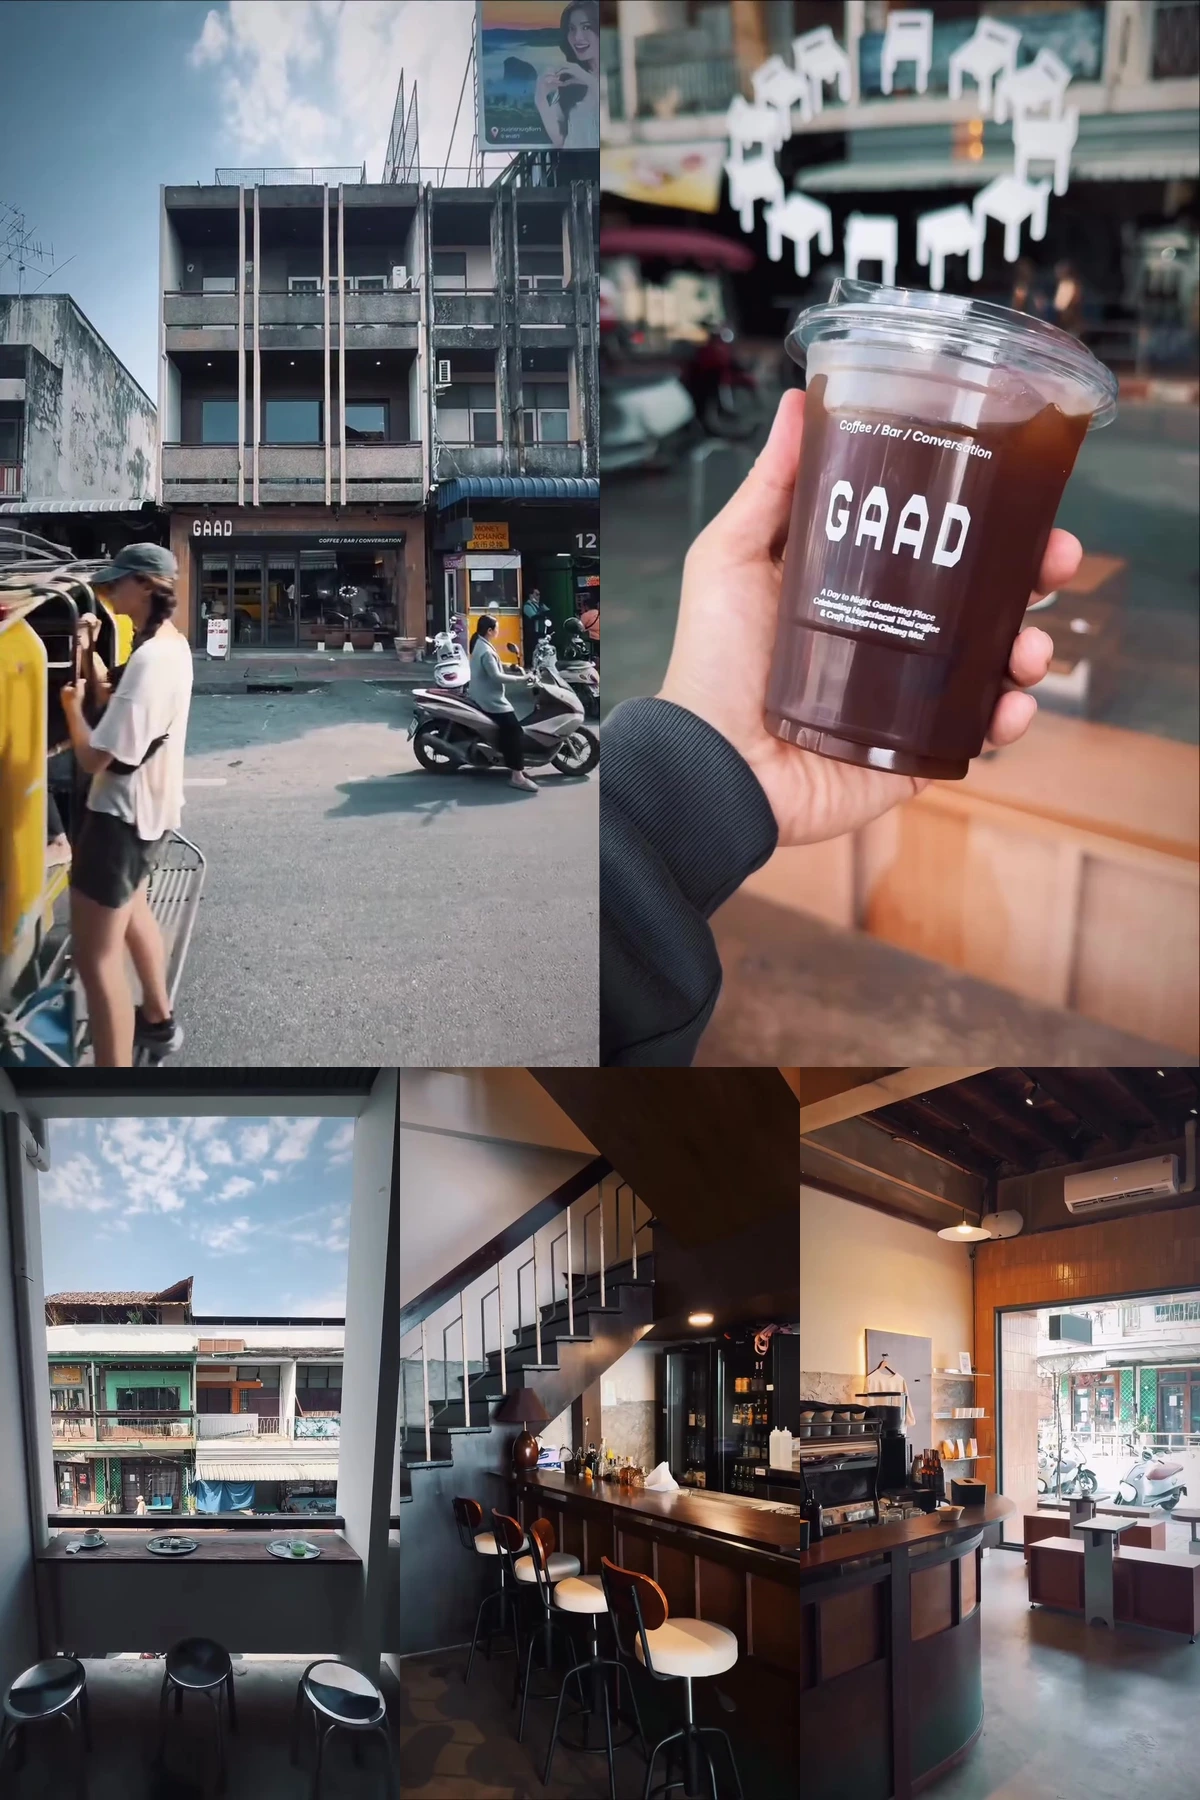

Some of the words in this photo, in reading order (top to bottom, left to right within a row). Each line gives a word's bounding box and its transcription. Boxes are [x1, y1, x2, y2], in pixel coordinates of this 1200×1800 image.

[839, 419, 871, 434] Coffee
[873, 423, 881, 436] /
[881, 424, 903, 438] Bar
[903, 428, 912, 441] /
[912, 430, 993, 460] Conversation
[193, 519, 233, 537] GAAD
[473, 533, 507, 541] XCHANGE
[825, 479, 971, 568] GAAD
[575, 533, 597, 549] 12
[813, 597, 852, 614] Celebrating
[852, 606, 896, 624] Hyperlocal
[896, 616, 915, 627] Thai
[915, 622, 940, 634] coffee
[820, 588, 826, 596] A
[827, 589, 841, 600] Day
[841, 593, 849, 601] to
[850, 595, 872, 607] Night
[872, 600, 912, 617] Gathering
[912, 609, 936, 622] Place
[820, 609, 826, 617] &
[826, 610, 845, 623] Craft
[845, 616, 869, 628] based
[869, 621, 878, 630] in
[878, 623, 908, 638] Chiang
